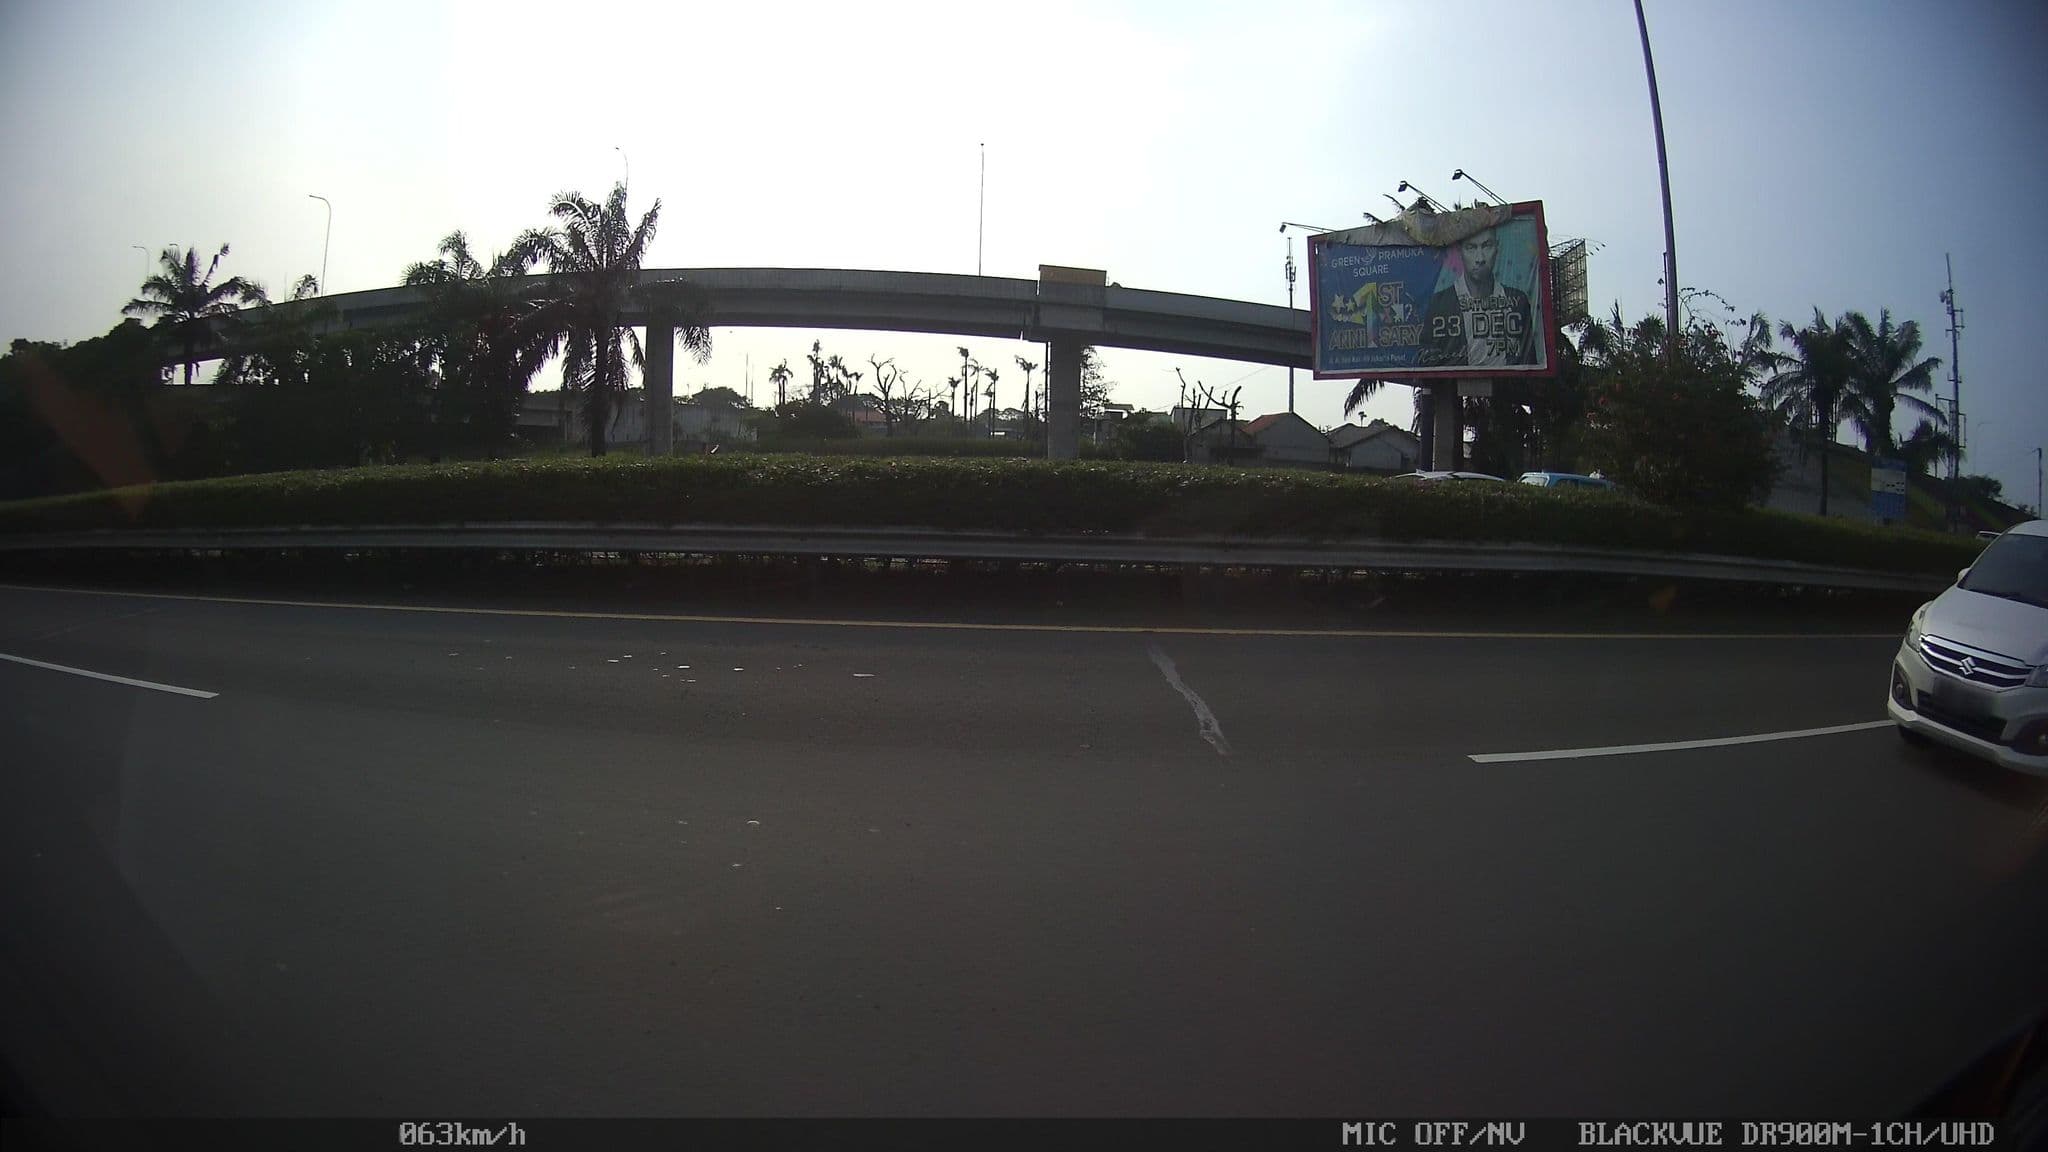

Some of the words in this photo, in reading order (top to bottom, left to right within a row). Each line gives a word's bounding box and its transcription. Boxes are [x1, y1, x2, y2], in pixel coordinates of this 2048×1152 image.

[1331, 255, 1361, 269] GREEN
[1378, 247, 1425, 261] PRAMUKA
[1353, 264, 1389, 278] SQUARE
[1459, 295, 1521, 311] SATURDAY
[1432, 315, 1461, 338] 23
[1473, 311, 1523, 338] DEC
[1486, 338, 1521, 357] 7PM
